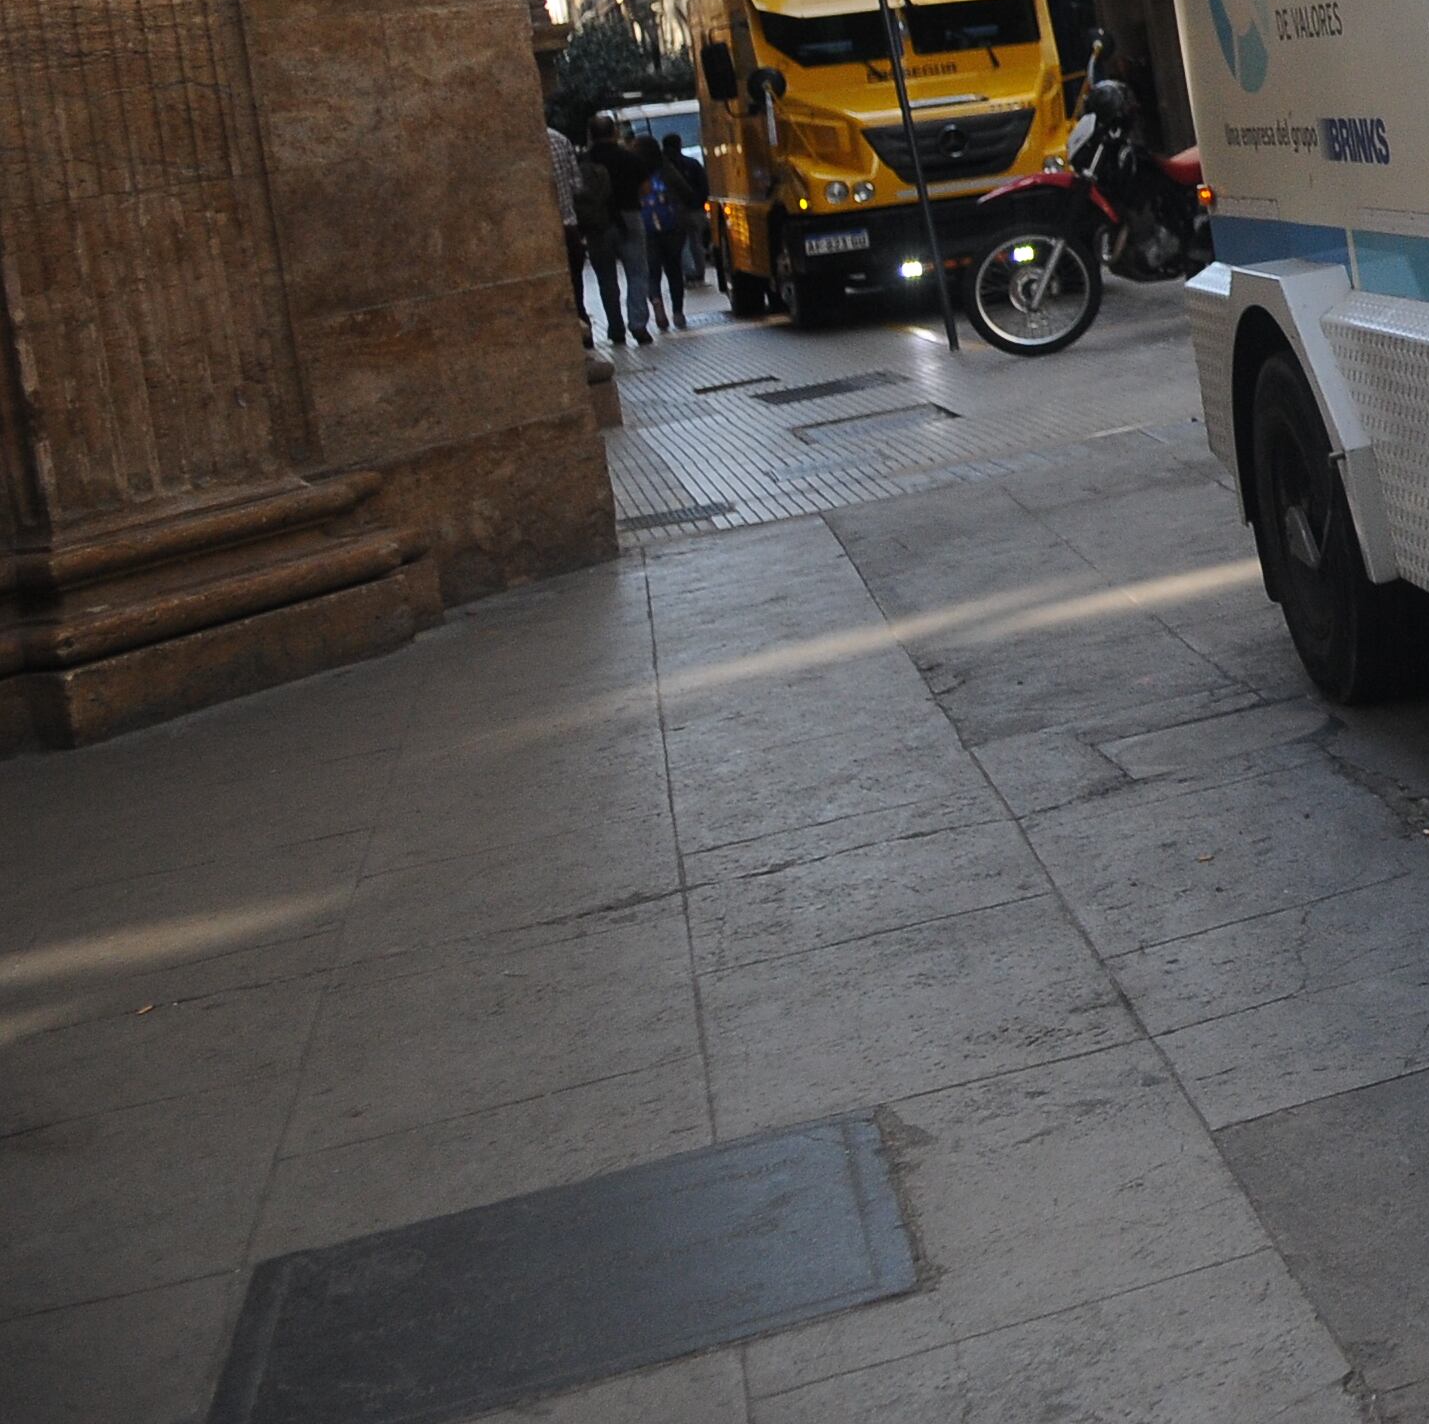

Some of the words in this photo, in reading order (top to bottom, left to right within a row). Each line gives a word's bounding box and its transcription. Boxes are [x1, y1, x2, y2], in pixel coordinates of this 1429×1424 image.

[1275, 8, 1292, 41] DE
[1291, 2, 1343, 40] VALORES
[1326, 117, 1390, 166] BRINKS
